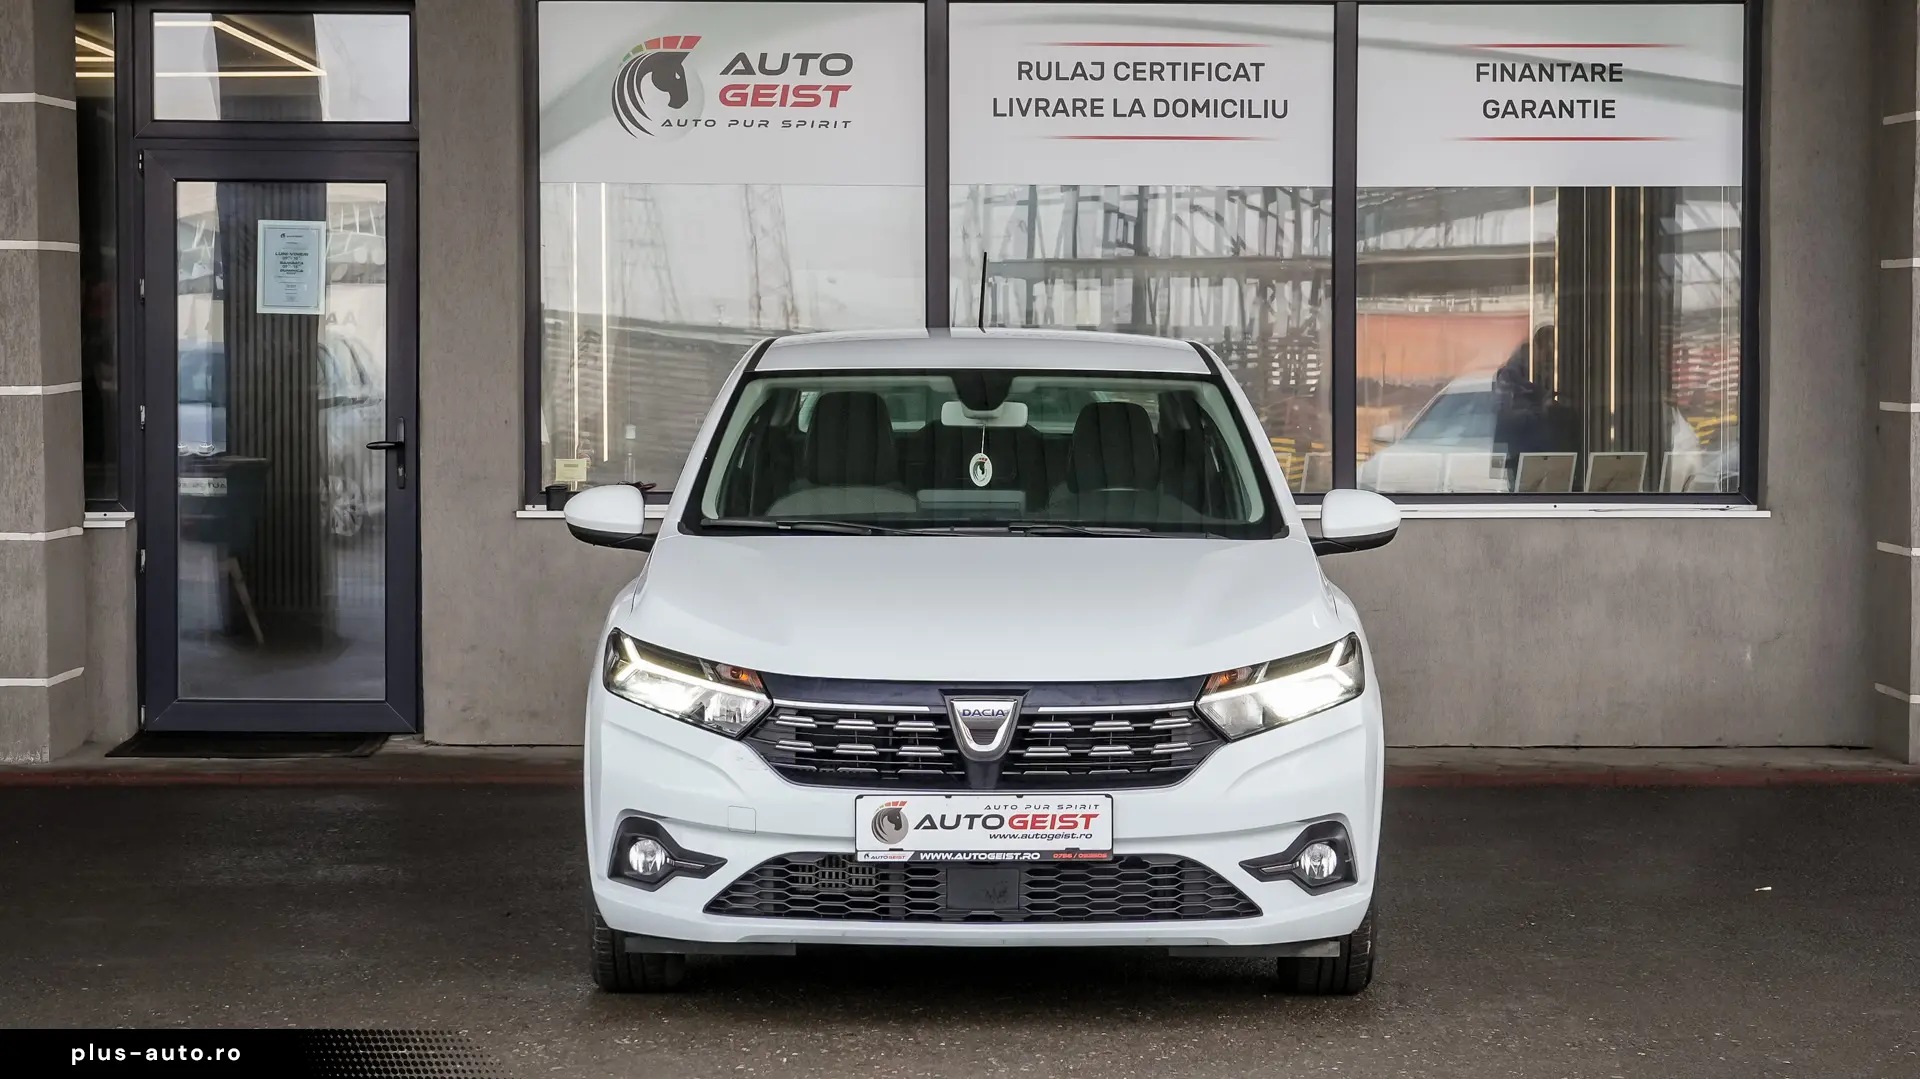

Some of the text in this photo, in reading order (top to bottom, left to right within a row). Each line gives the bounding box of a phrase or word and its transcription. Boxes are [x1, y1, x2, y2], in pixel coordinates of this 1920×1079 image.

[719, 52, 854, 77] AUTO
[1016, 61, 1266, 82] RULAJ CERTIFICAT
[1475, 62, 1624, 83] FINANTARE
[718, 83, 853, 108] GEIST
[992, 97, 1289, 119] LIVRARE LA DOMICILIU
[1482, 99, 1616, 119] GARANTIE
[660, 118, 852, 129] AUTO PUR SPIRIT
[962, 708, 1006, 717] DACIA
[913, 813, 1100, 831] AUTOGEIST
[989, 832, 1093, 841] www.autogeist.ro
[919, 852, 1041, 861] WWW.AUTOGEIST.RO
